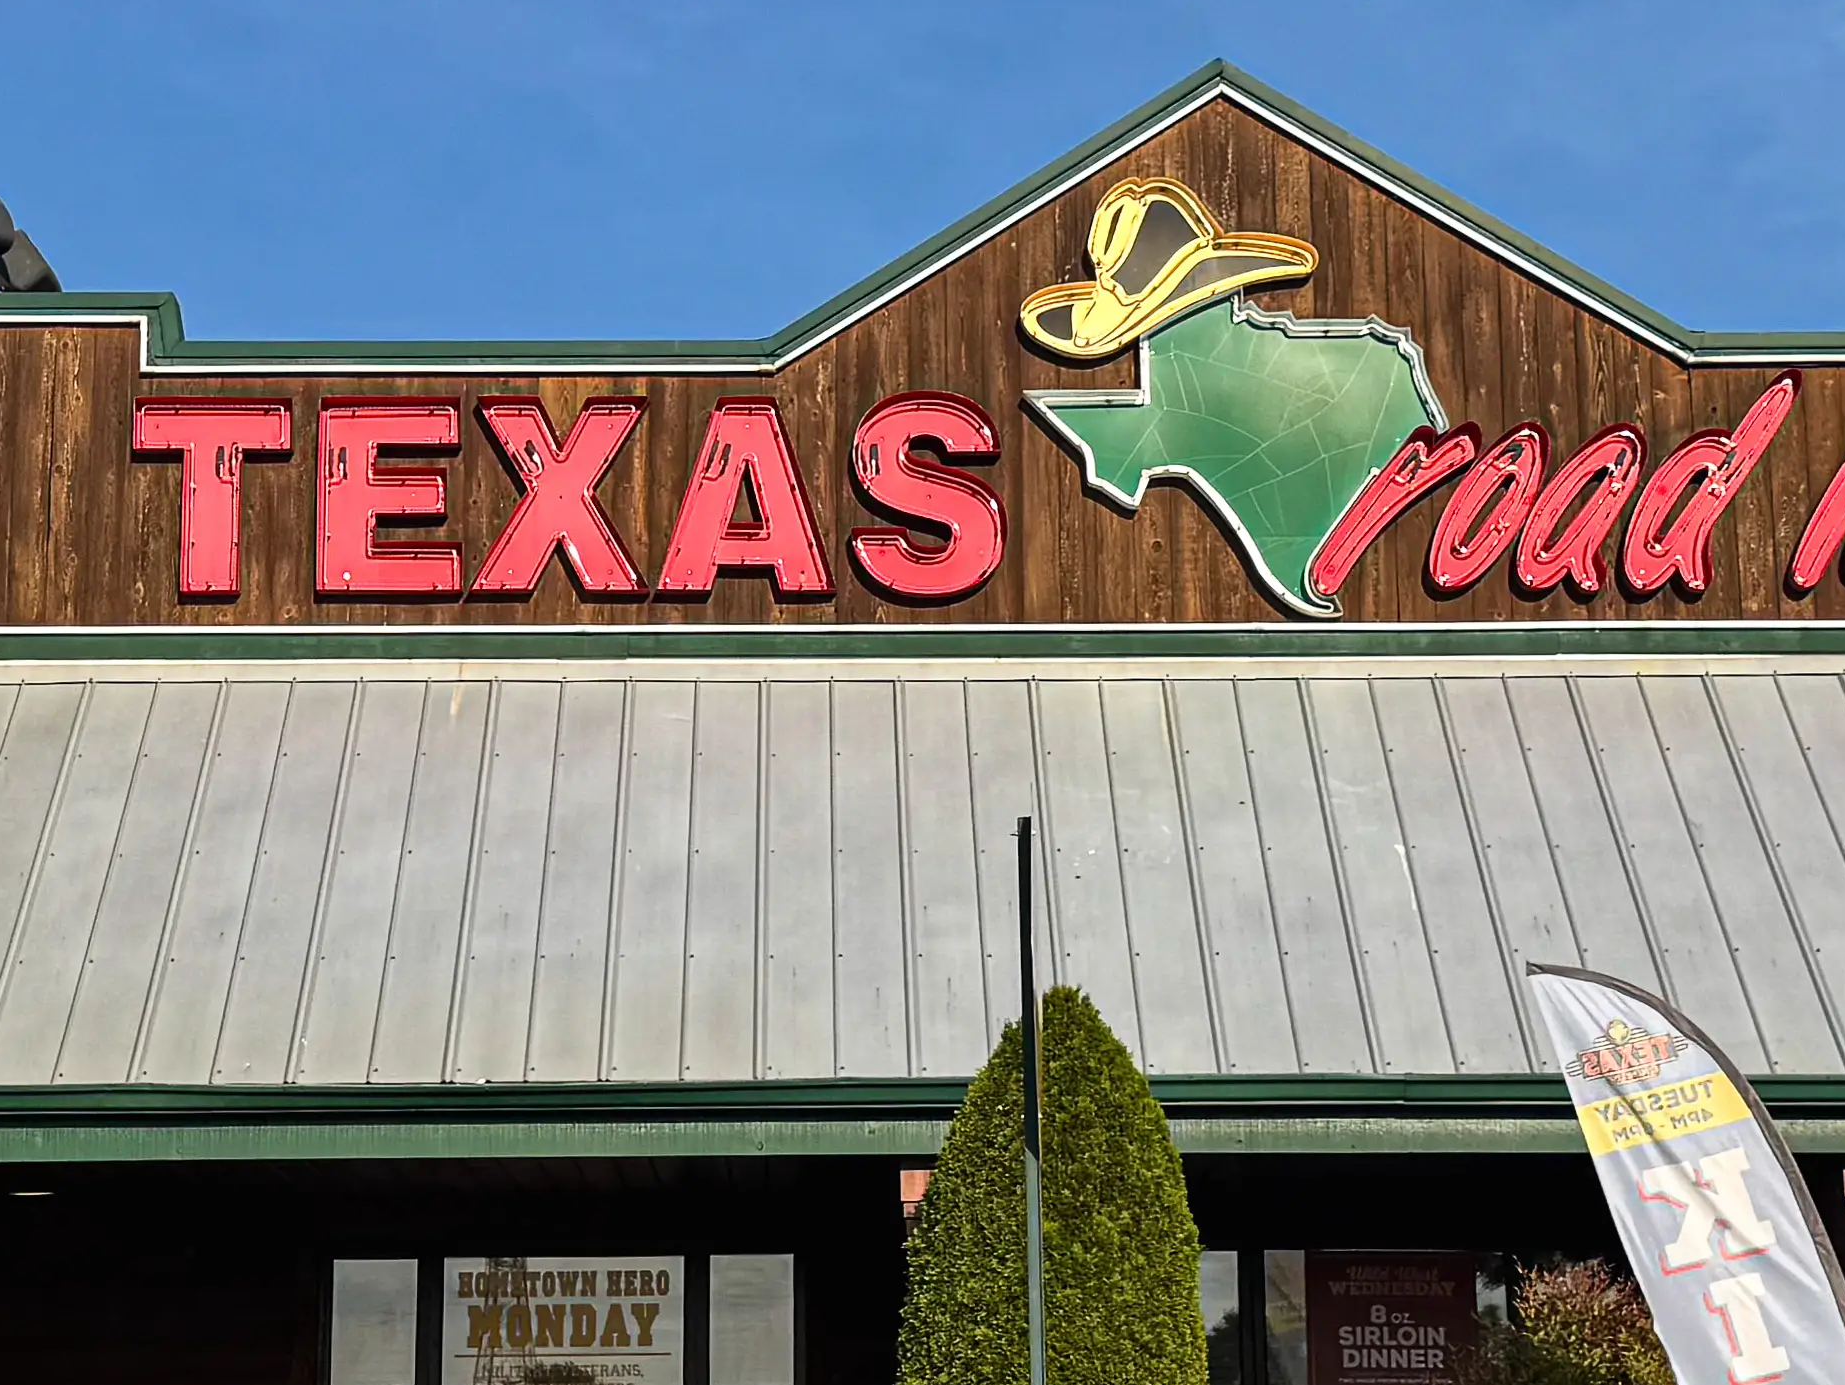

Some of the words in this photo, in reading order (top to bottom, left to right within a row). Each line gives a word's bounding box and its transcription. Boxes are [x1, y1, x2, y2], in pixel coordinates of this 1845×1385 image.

[131, 390, 1009, 609] TEXAS
[1309, 368, 1804, 601] road
[458, 1271, 598, 1298] HOMETOWN
[607, 1270, 670, 1296] HERO
[1328, 1281, 1456, 1296] WEDNESDAY
[1370, 1305, 1387, 1324] 8
[467, 1303, 660, 1348] MONDAY
[1338, 1326, 1446, 1347] SIRLOIN
[1342, 1348, 1444, 1369] DINNER
